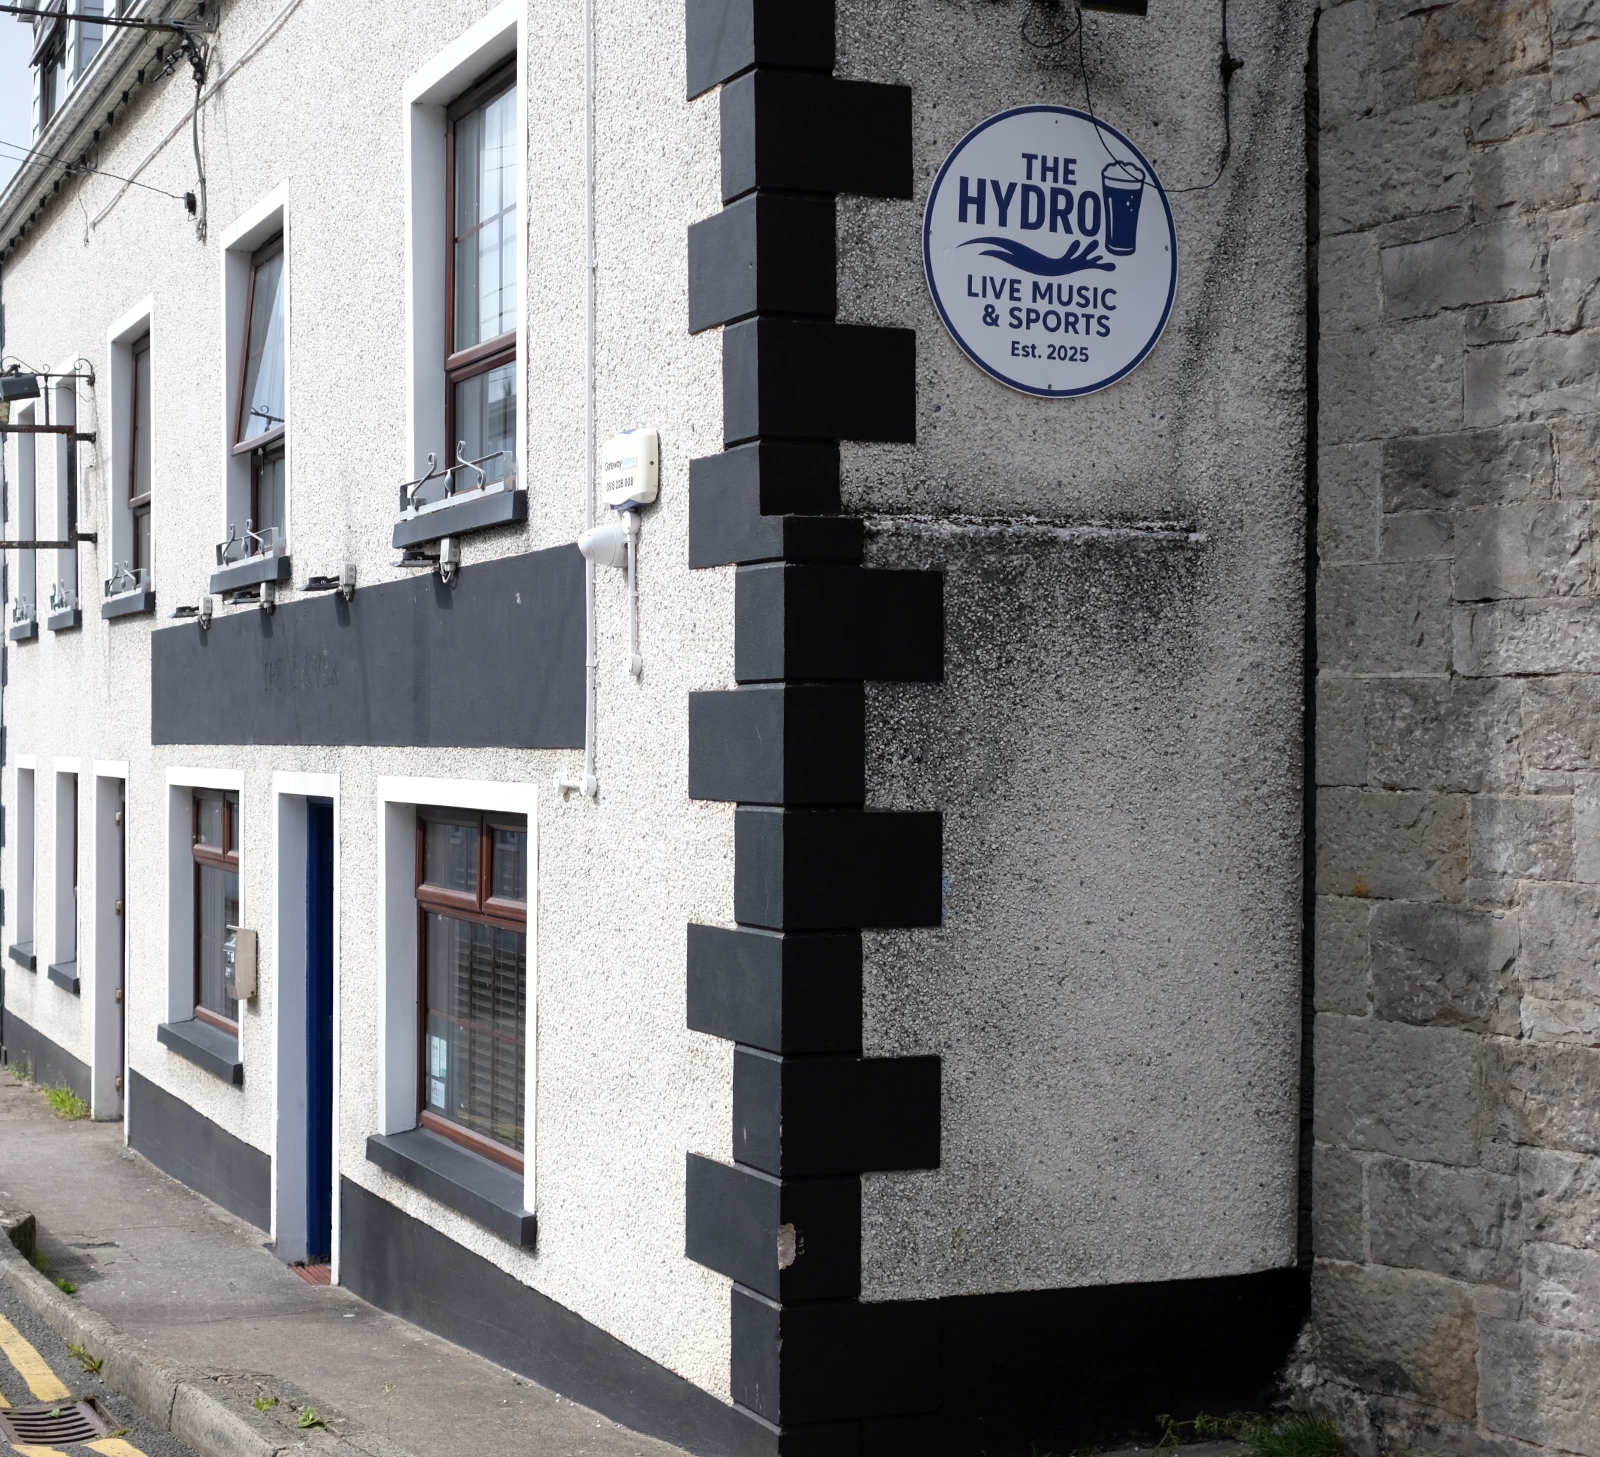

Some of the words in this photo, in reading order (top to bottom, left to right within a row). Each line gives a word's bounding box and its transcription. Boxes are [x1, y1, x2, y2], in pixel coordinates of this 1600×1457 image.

[1021, 152, 1077, 186] THE
[958, 175, 1101, 237] HYDRO
[967, 273, 1022, 302] LIVE
[1032, 280, 1118, 311] MUSIC
[982, 303, 1001, 328] &
[1008, 307, 1111, 338] SPORTS
[1010, 340, 1042, 359] Est.
[1046, 343, 1090, 363] 2025
